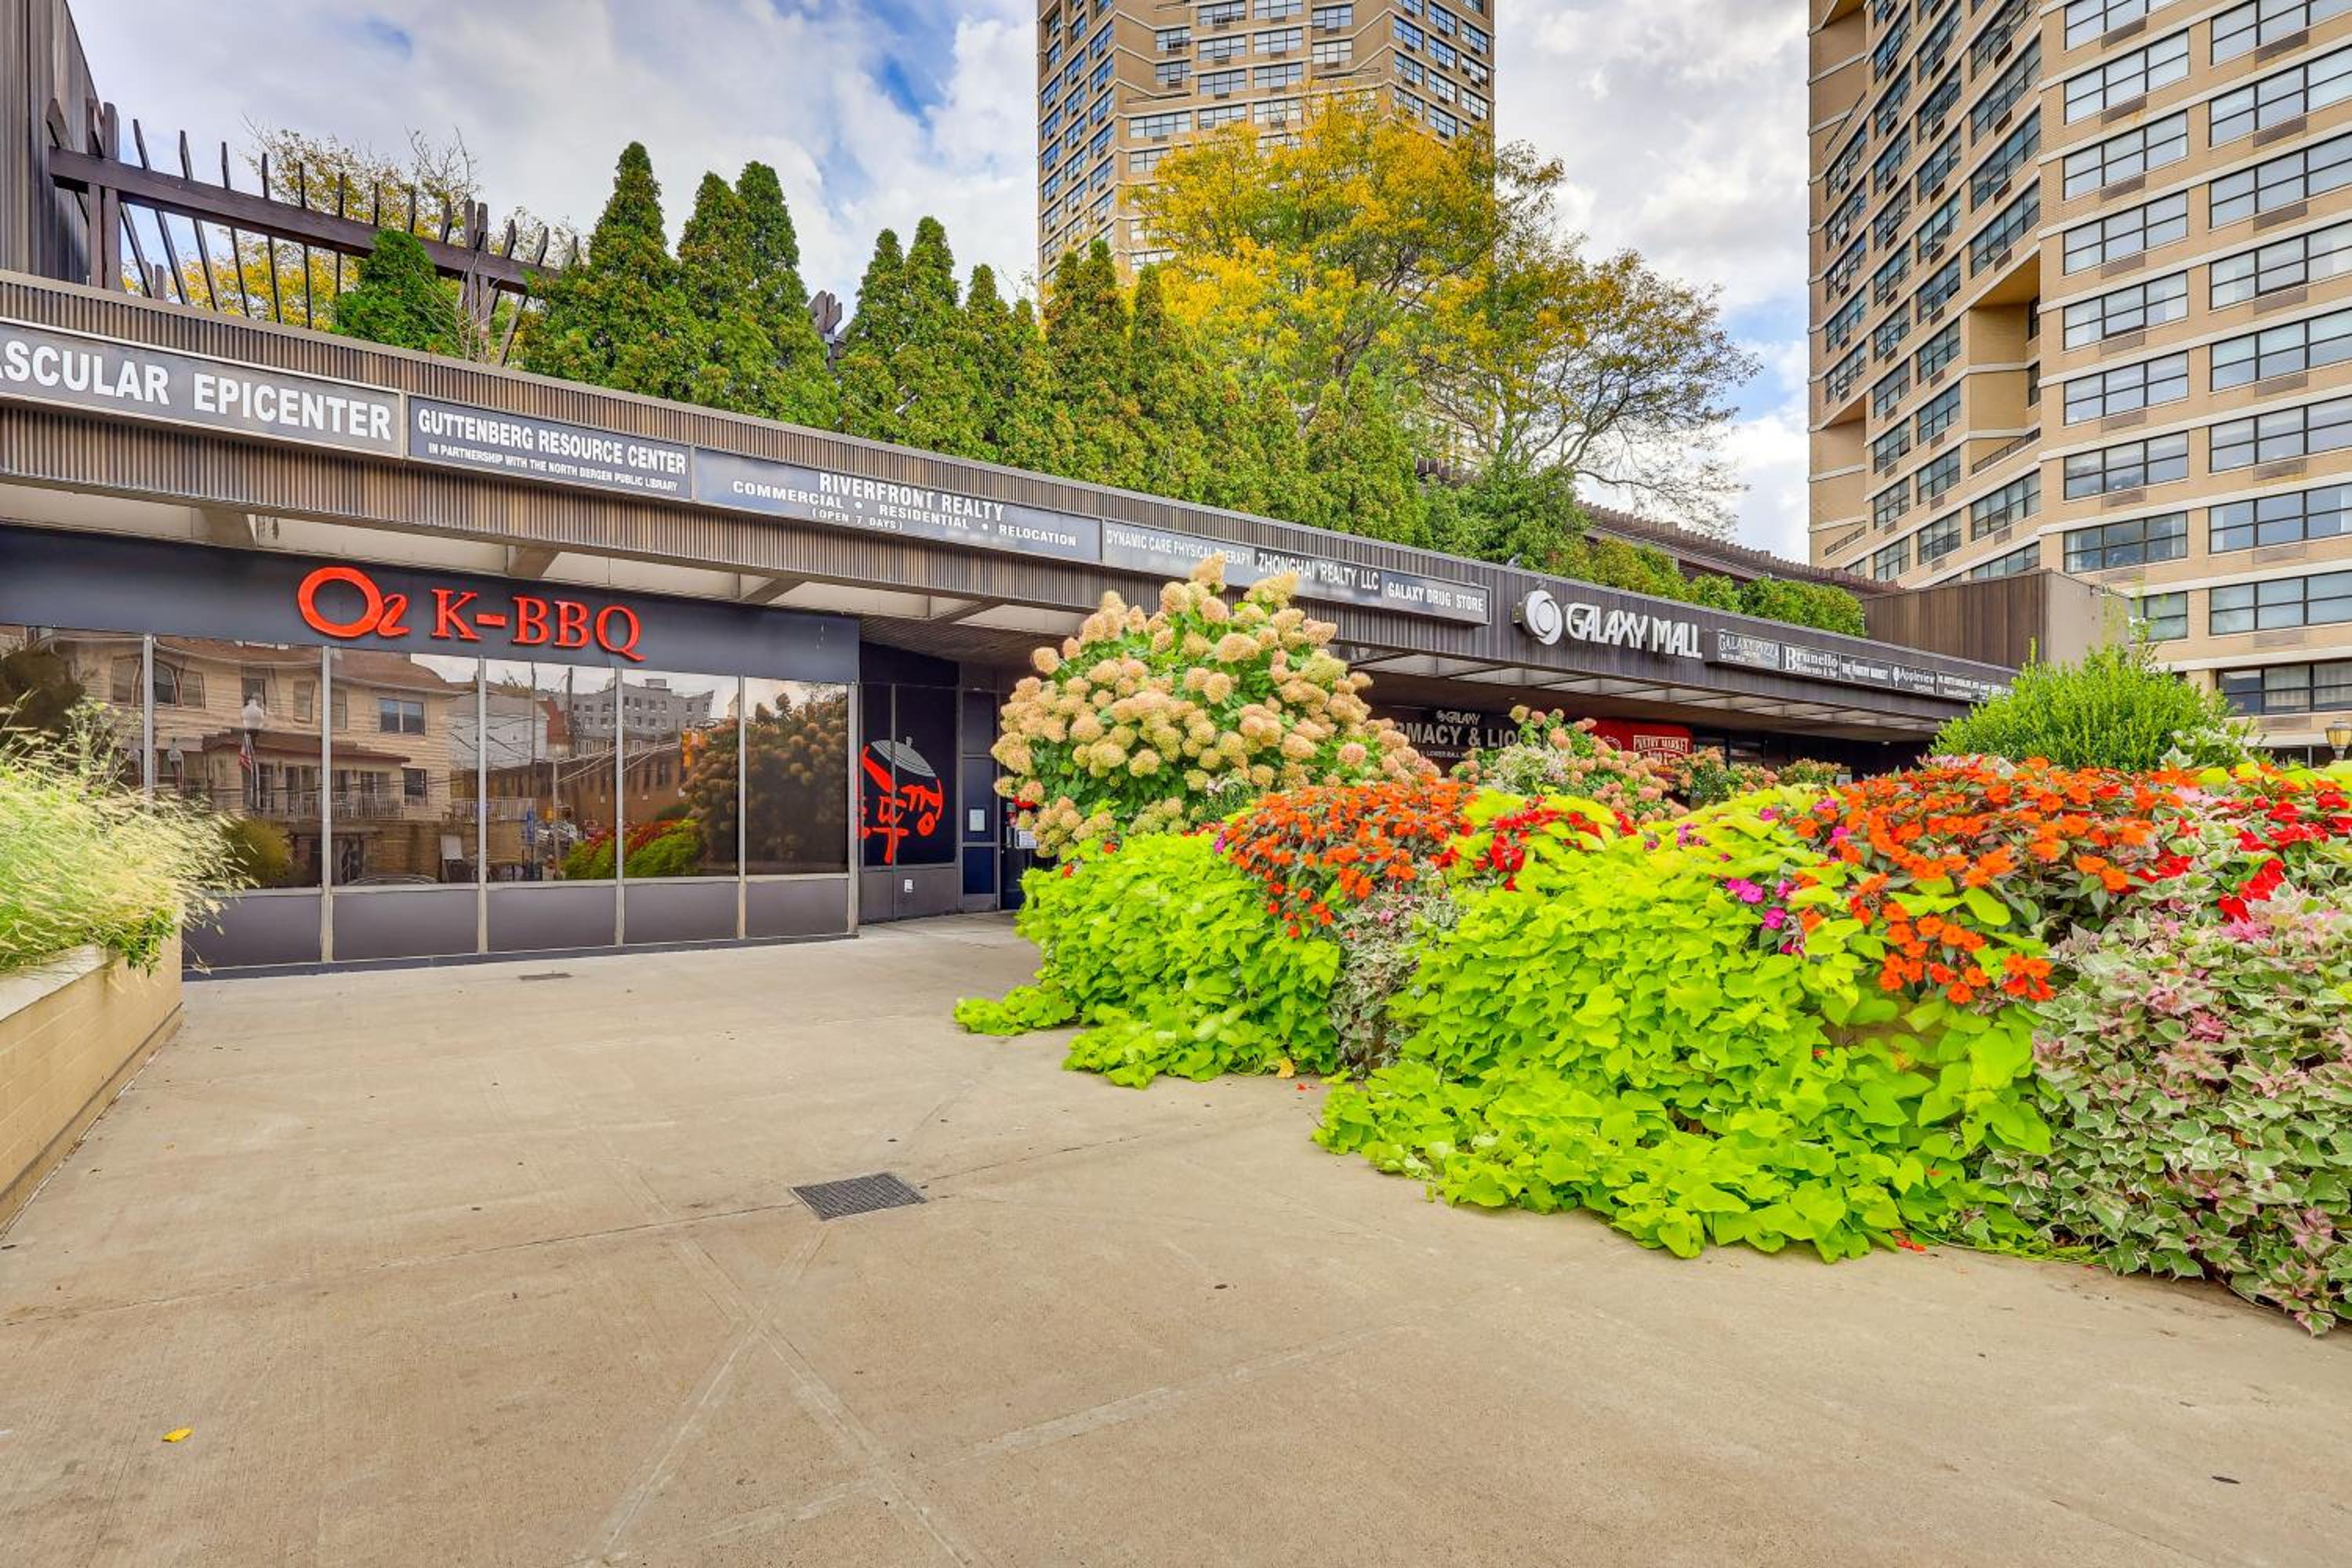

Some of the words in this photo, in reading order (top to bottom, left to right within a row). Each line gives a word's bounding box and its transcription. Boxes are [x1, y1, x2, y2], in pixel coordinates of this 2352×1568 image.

[0, 339, 170, 405] SCULAR
[193, 372, 392, 441] EPICENTER
[418, 408, 535, 450] GUTTENBERG
[539, 429, 624, 465] RESOURCE
[627, 445, 686, 475] CENTER
[428, 442, 439, 455] IN
[440, 445, 504, 465] PARTNERSHIP
[504, 454, 528, 469] WITH
[529, 459, 547, 471] THE
[548, 460, 578, 477] NORTH
[579, 466, 612, 482] BERGEN
[614, 472, 644, 487] PUBLIC
[645, 477, 678, 492] LIBRARY
[732, 480, 844, 510] COMMERCIAL
[879, 504, 970, 530] RESIDENTIAL
[998, 524, 1076, 547] RELOCATION
[818, 472, 935, 510] RIVERFRONT
[941, 493, 1004, 521] REALTY
[855, 515, 862, 524] 7
[1106, 529, 1147, 549] DYNAMIC
[1149, 536, 1172, 554] CARE
[1174, 540, 1212, 559] PHYSICAL
[1214, 547, 1251, 565] TERAPY
[1258, 552, 1316, 579] ZHONGHAI
[1319, 562, 1358, 587] REALTY
[1360, 569, 1379, 590] LLC
[1387, 581, 1425, 603] GALAXY
[1426, 589, 1451, 608] DRUG
[1456, 593, 1485, 613] STORE
[430, 588, 647, 662] K-BBQ
[1566, 602, 1649, 650] GALAXY
[1652, 616, 1703, 659] MALL
[1784, 645, 1838, 670] Brunello
[1446, 711, 1481, 725] GALAXY
[1468, 727, 1481, 747] &
